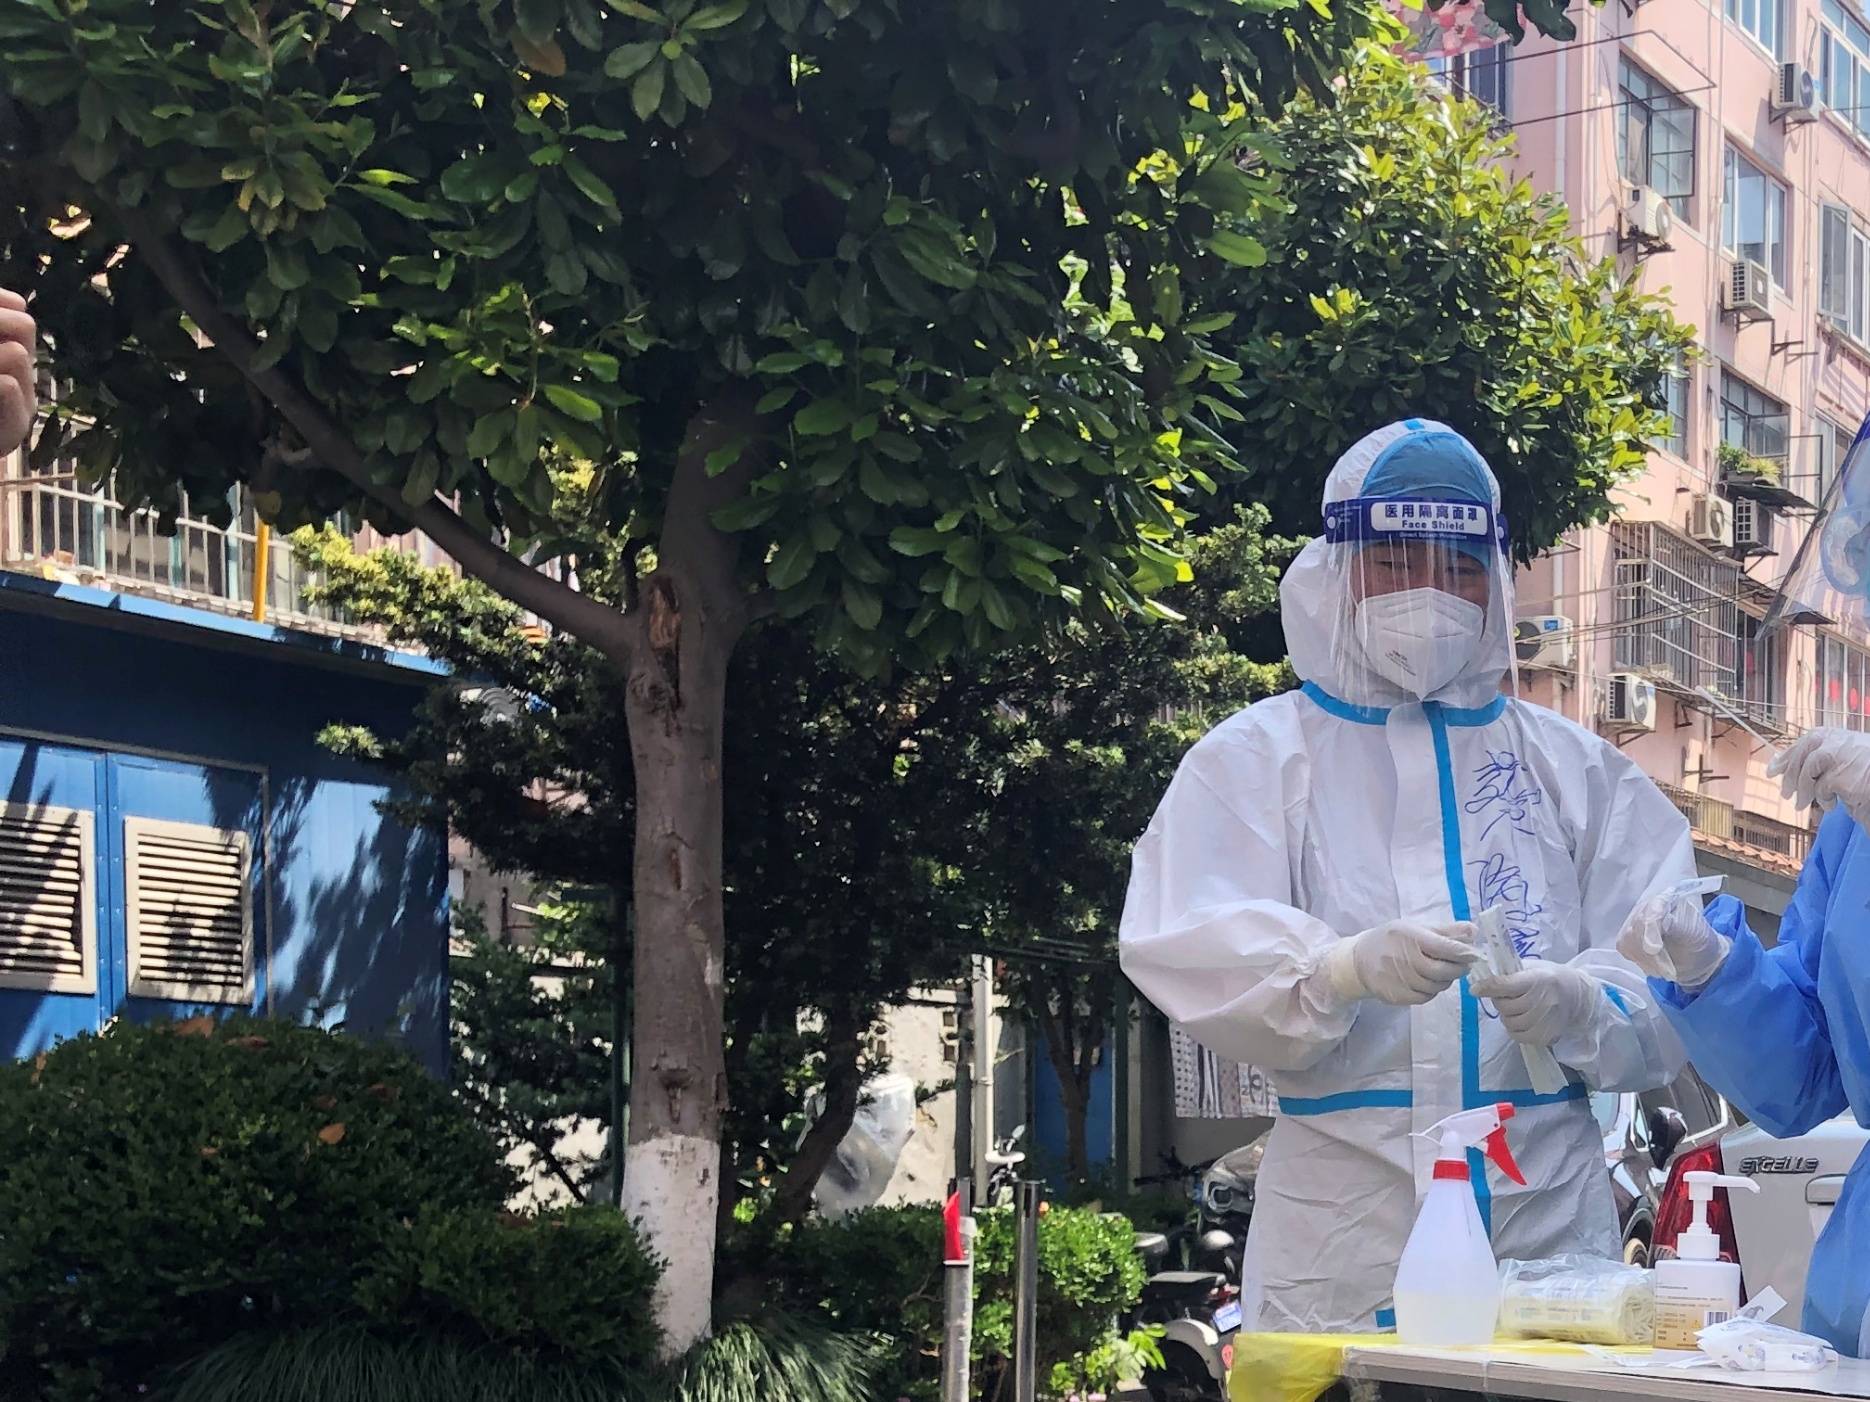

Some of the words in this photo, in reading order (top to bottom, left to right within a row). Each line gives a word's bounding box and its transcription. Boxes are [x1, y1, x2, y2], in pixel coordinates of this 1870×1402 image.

[1384, 503, 1479, 521] 医用隔离面罩
[1401, 519, 1427, 530] Face
[1431, 520, 1465, 531] Shield
